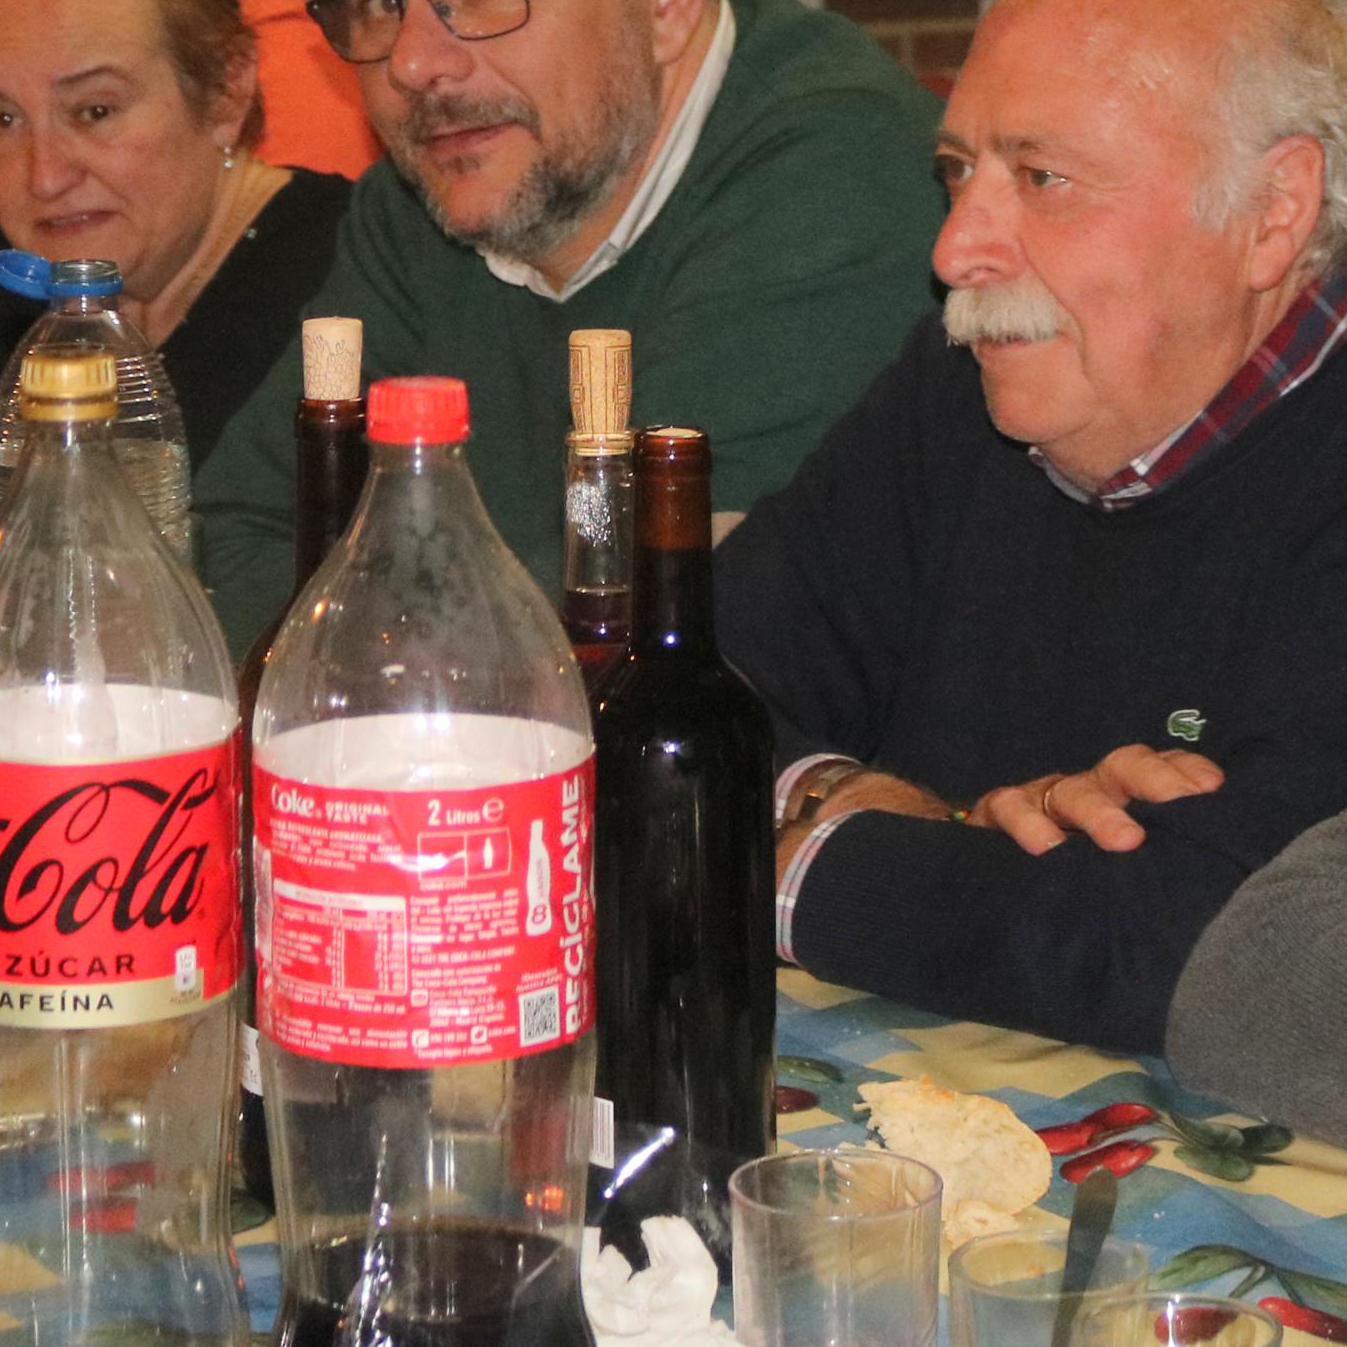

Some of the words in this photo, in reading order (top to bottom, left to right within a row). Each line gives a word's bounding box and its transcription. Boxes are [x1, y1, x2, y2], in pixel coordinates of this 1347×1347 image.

[325, 801, 390, 817] ORIGINAL
[326, 810, 369, 825] TASTE
[428, 799, 441, 826] 2
[446, 808, 481, 825] Litros
[532, 903, 547, 925] 8
